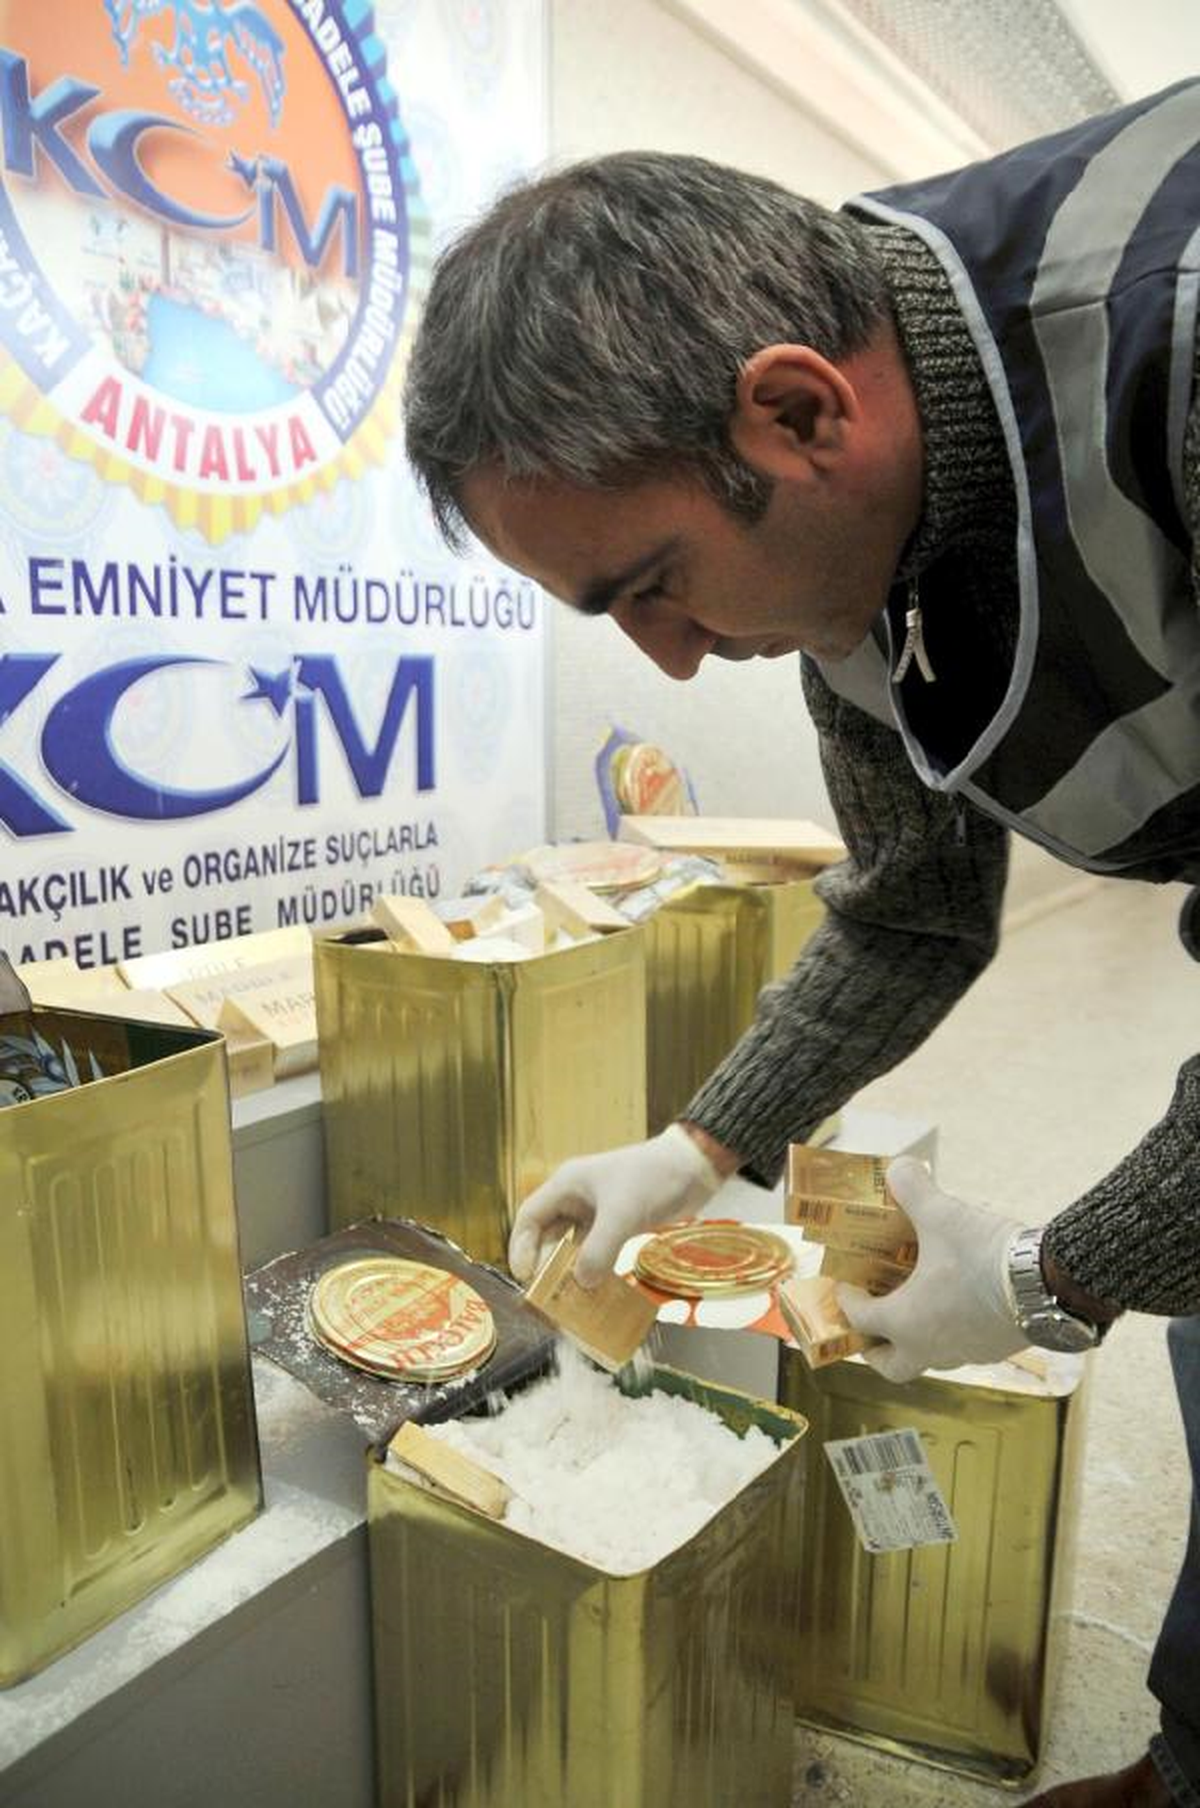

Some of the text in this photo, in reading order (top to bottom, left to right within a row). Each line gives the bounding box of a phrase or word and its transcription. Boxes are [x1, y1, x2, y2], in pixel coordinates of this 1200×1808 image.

[353, 122, 396, 224] ŞUBE
[80, 375, 317, 483] ANTALYA
[28, 555, 536, 631] EMNİYET MÜDÜRLÜĞÜ
[0, 821, 439, 922] AKÇILIK ve ORGANİZE SUÇLARLA
